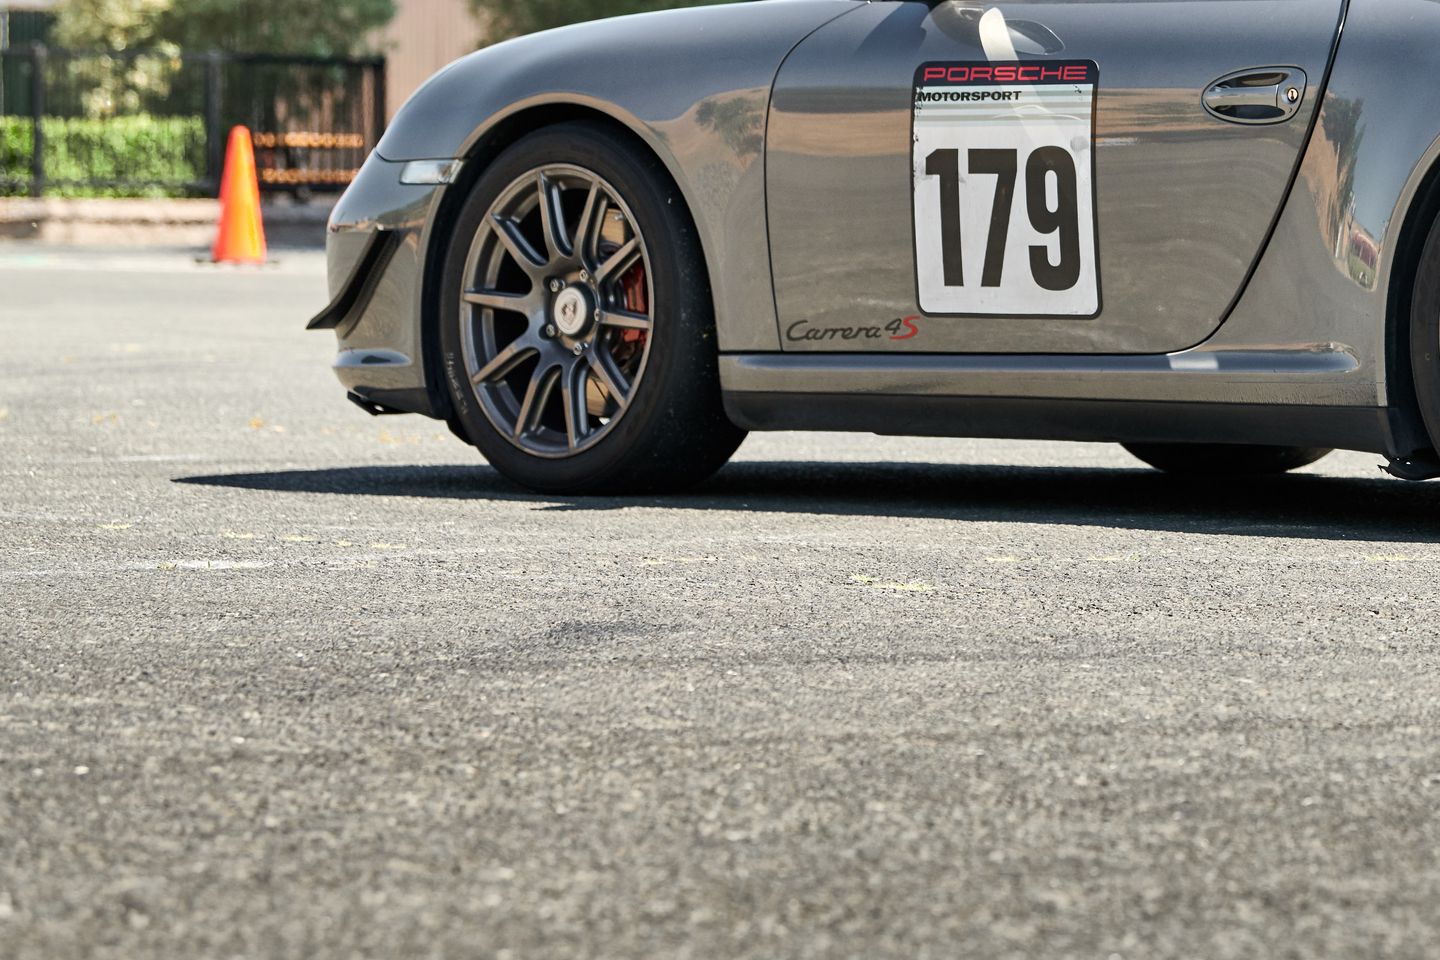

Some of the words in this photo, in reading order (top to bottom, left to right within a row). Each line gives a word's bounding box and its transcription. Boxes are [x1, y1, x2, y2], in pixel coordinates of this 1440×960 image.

[923, 65, 1088, 82] PORSCHE
[918, 90, 1022, 102] MOTORSPORT
[925, 145, 1081, 291] 179
[786, 320, 882, 341] Carrera
[884, 315, 921, 340] 4S
